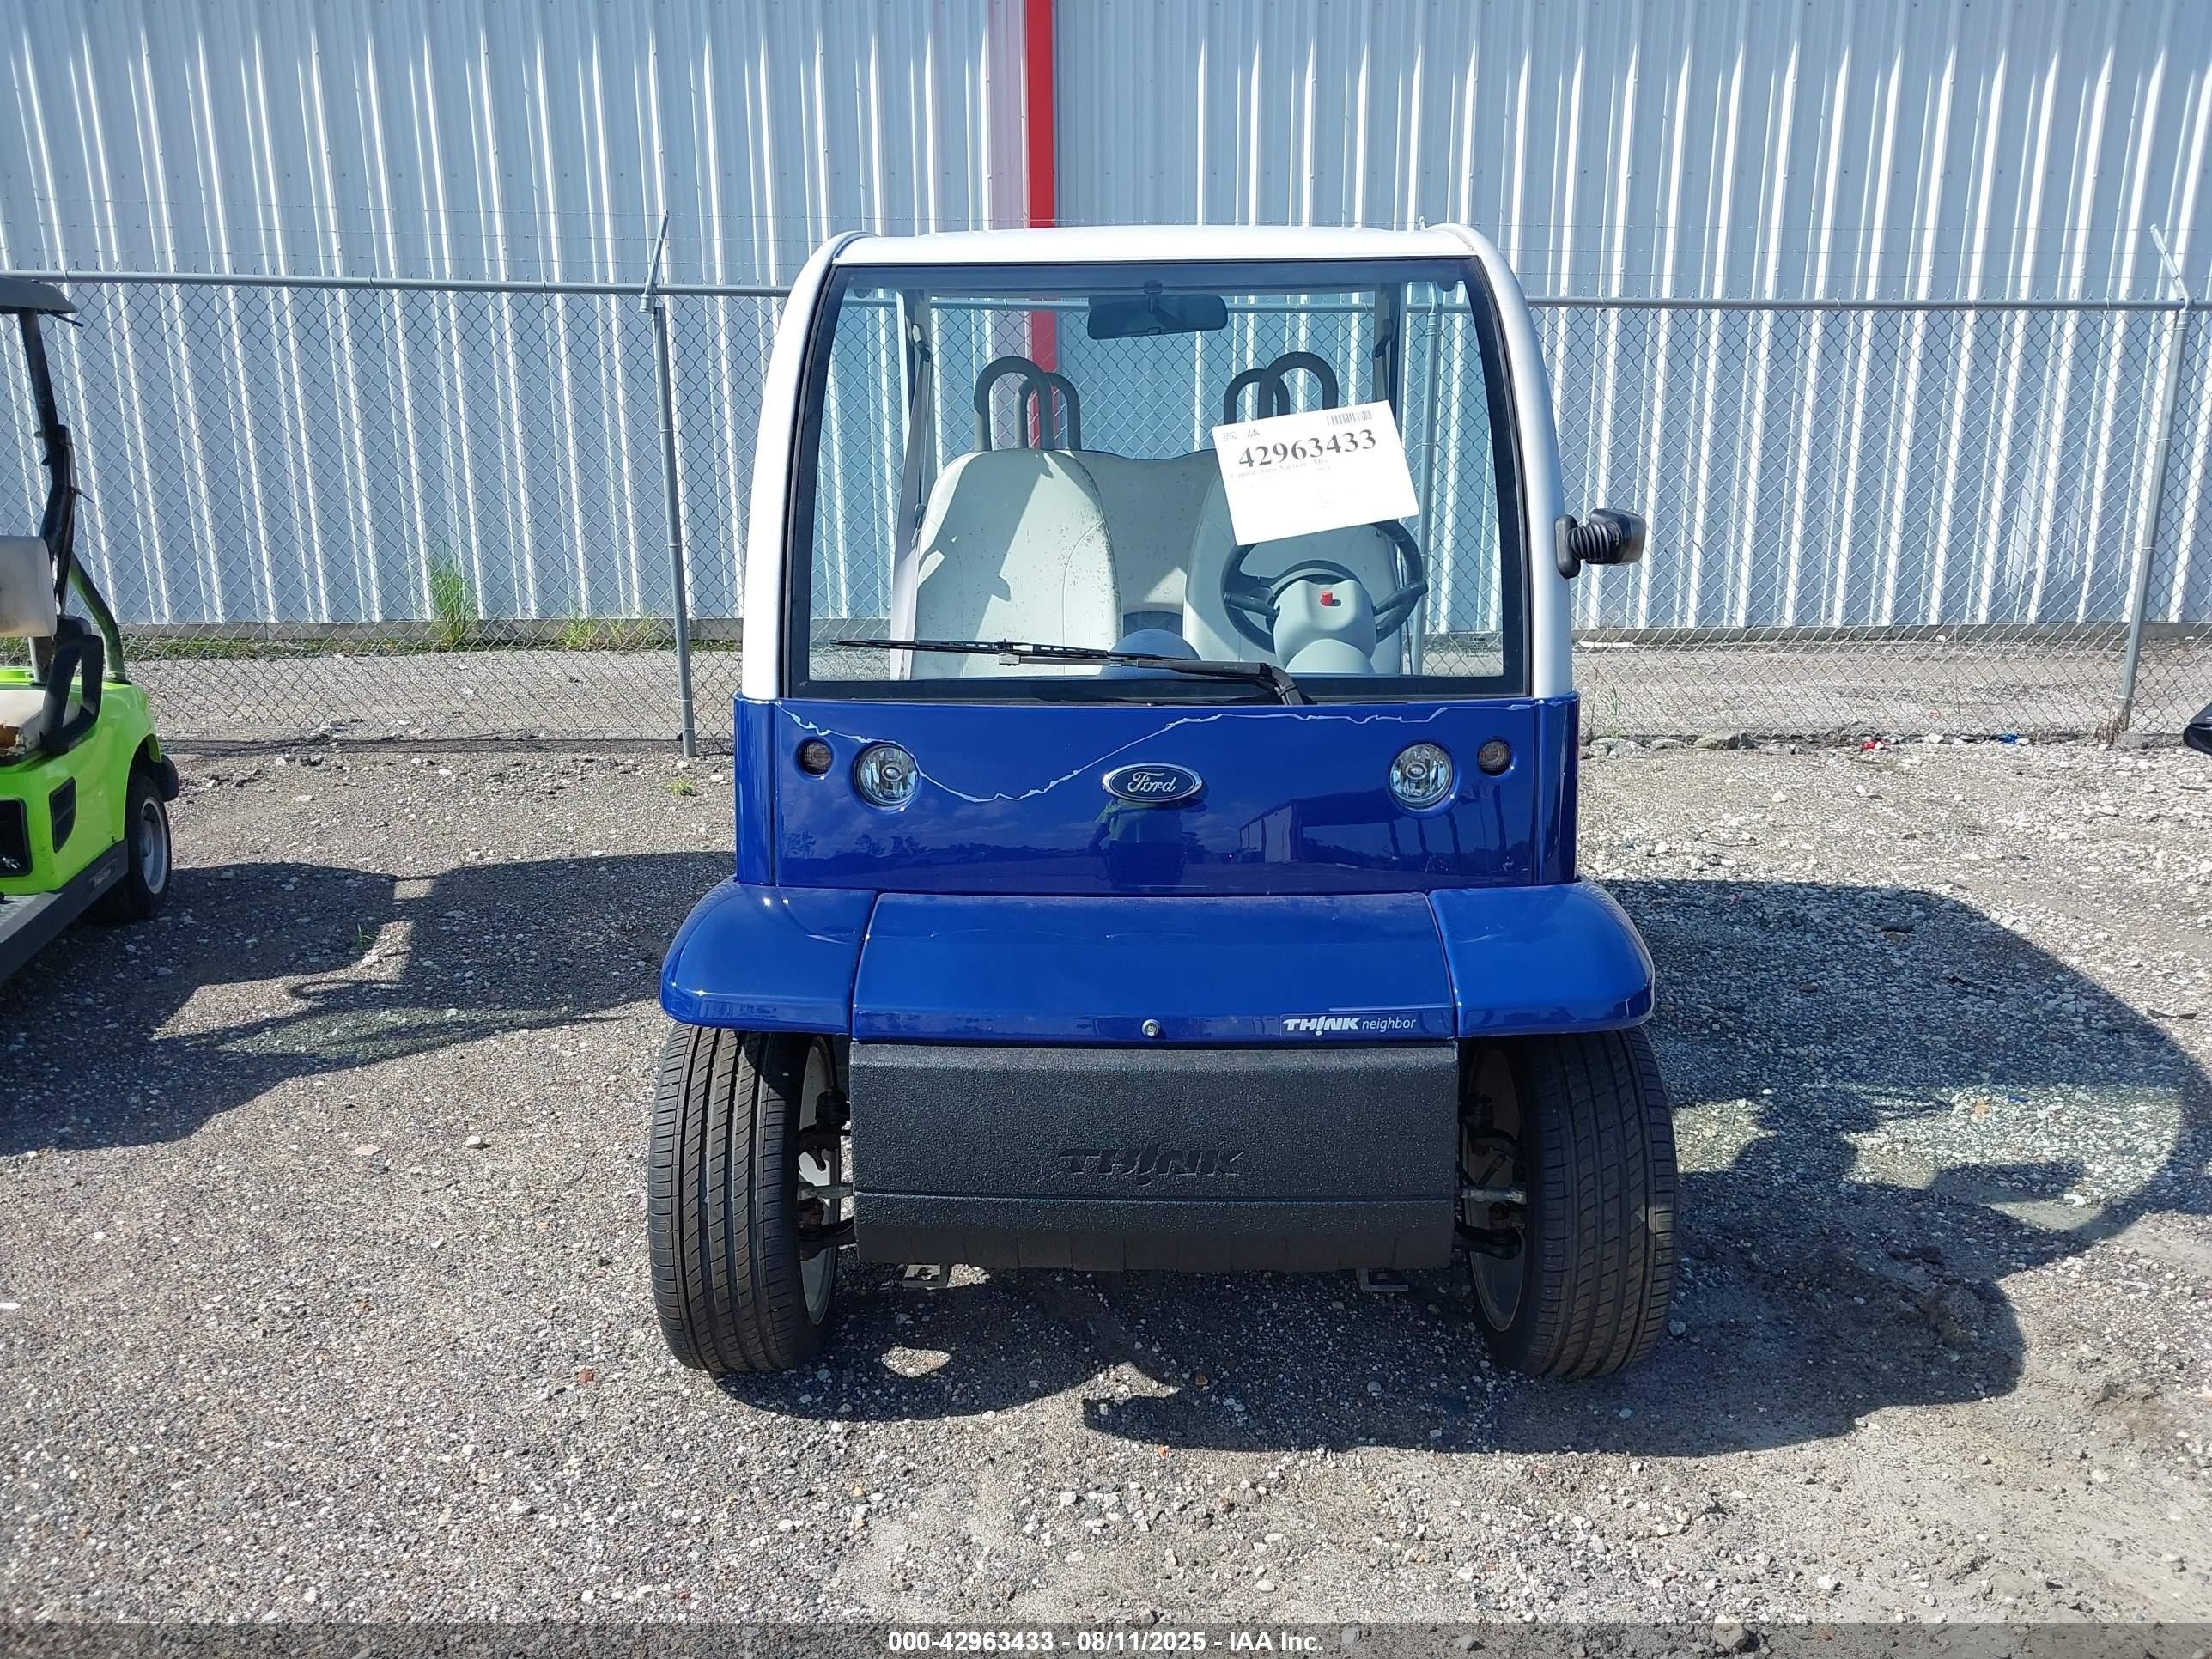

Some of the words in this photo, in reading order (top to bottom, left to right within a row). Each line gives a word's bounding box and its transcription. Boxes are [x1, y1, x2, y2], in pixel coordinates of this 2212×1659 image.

[1238, 428, 1376, 468] 42963433
[1127, 771, 1177, 793] Ford
[1362, 1017, 1417, 1033] neighbor
